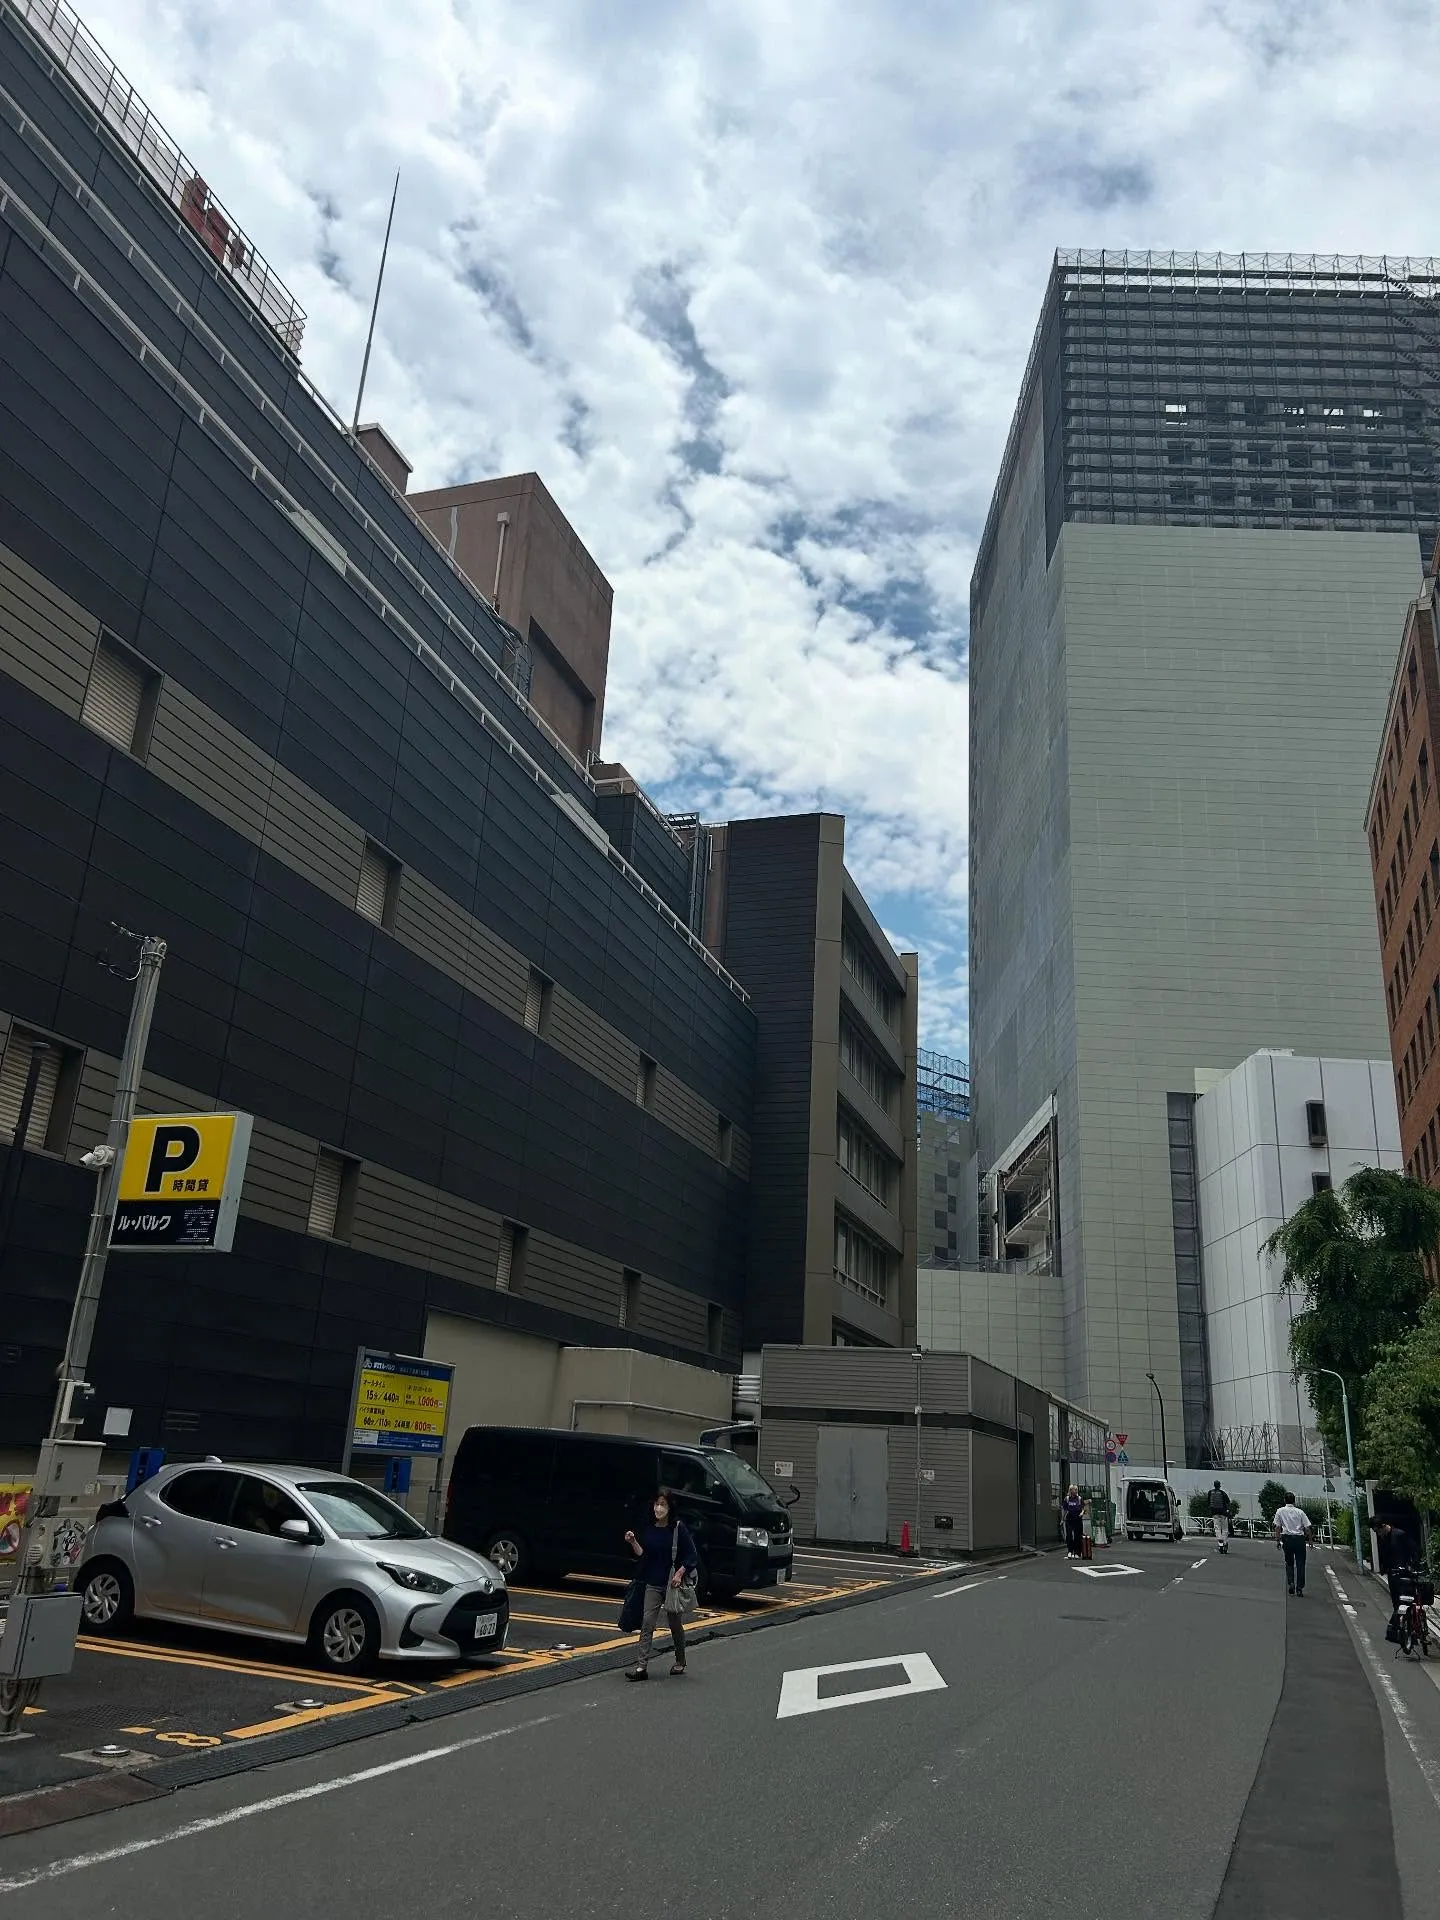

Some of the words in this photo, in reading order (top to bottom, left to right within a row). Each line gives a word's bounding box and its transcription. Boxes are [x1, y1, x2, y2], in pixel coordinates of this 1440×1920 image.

[145, 1125, 200, 1192] P
[173, 1179, 209, 1192] 時間貸
[118, 1215, 171, 1231] ル・パルク
